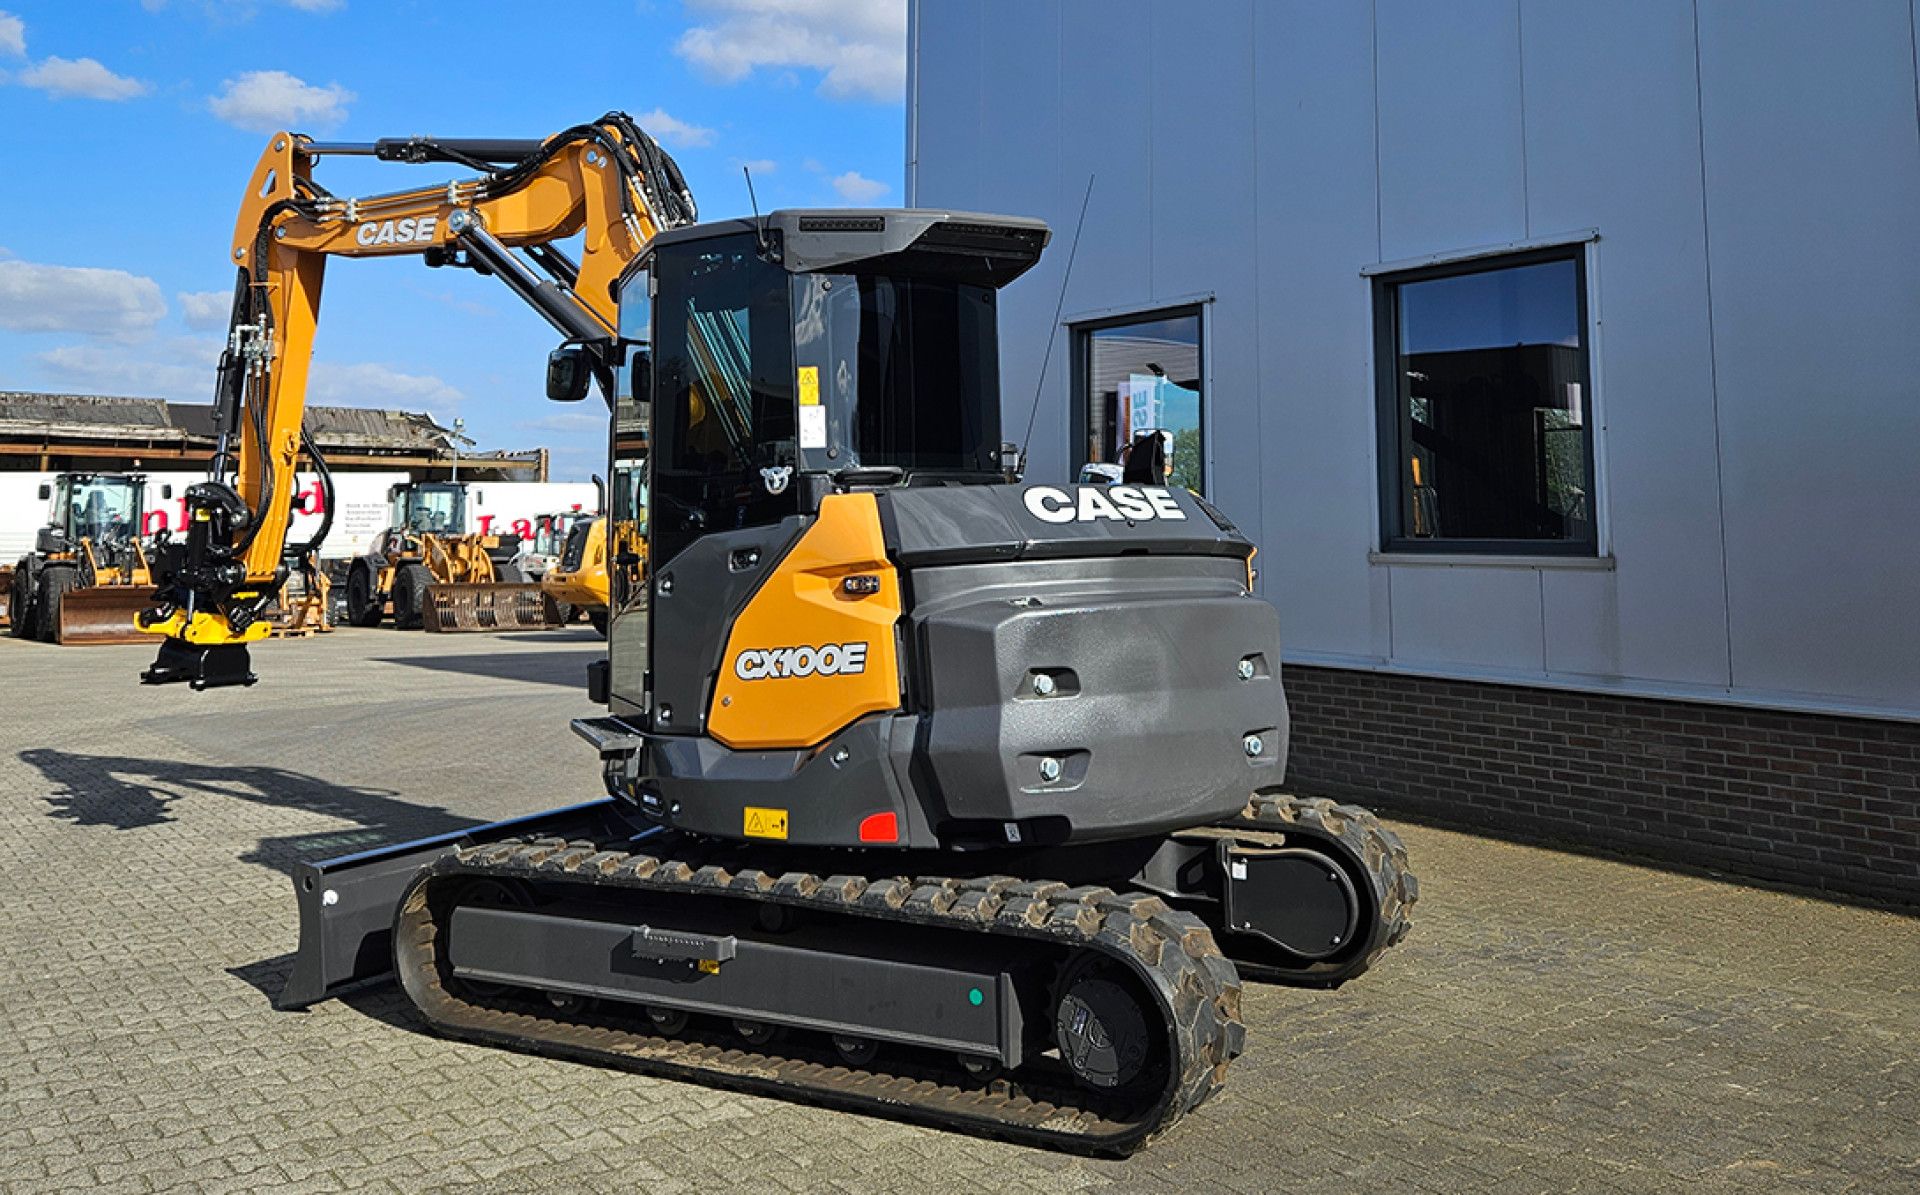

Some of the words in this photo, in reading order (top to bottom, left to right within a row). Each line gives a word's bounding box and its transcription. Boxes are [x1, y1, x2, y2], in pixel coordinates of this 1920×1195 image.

[357, 218, 437, 245] CASE
[1023, 486, 1187, 523] CASE
[735, 641, 867, 680] CX100E
